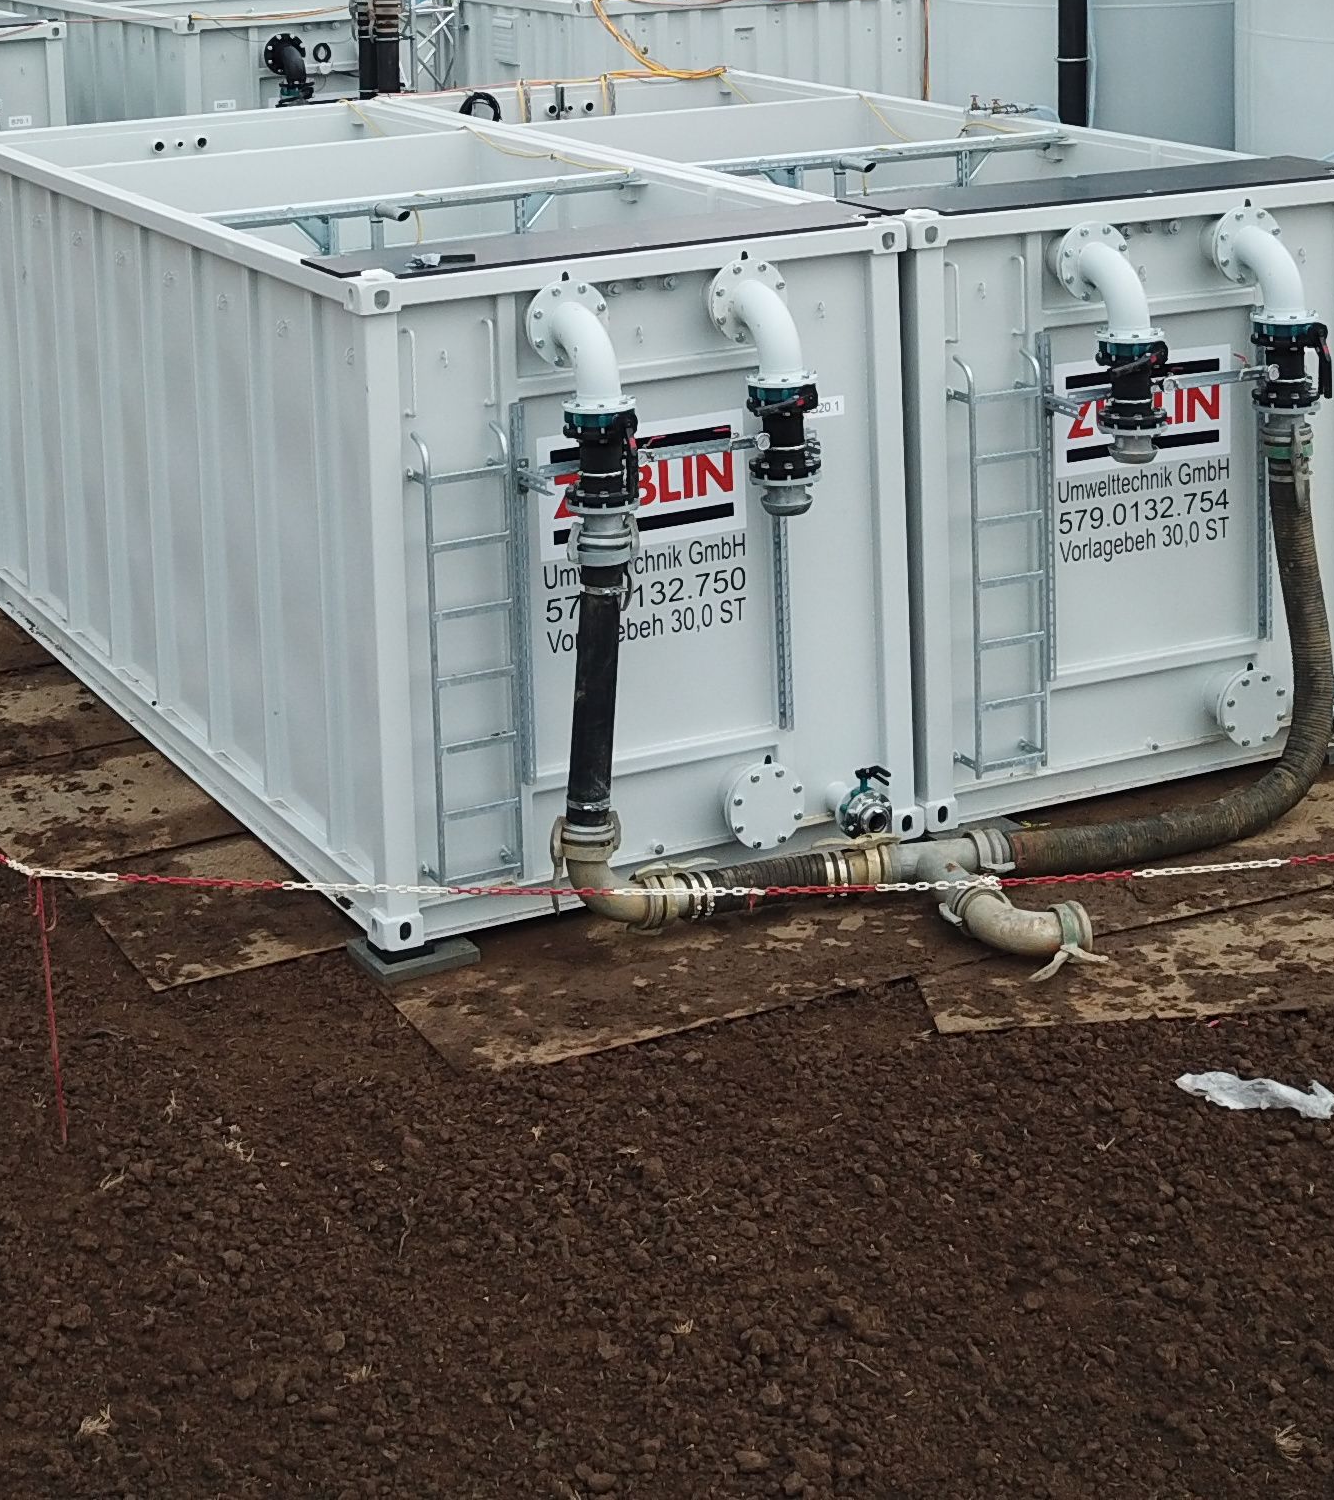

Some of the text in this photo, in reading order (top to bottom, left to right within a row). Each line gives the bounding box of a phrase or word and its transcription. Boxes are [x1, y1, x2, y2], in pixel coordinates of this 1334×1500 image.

[1058, 458, 1230, 503] Umwelttechnik GmbH
[1059, 488, 1229, 534] 579.0132.754
[688, 532, 746, 565] GmbH
[1059, 516, 1230, 563] Vorlagebeh 30,0 ST
[670, 602, 713, 634] 30,0
[720, 597, 747, 625] ST
